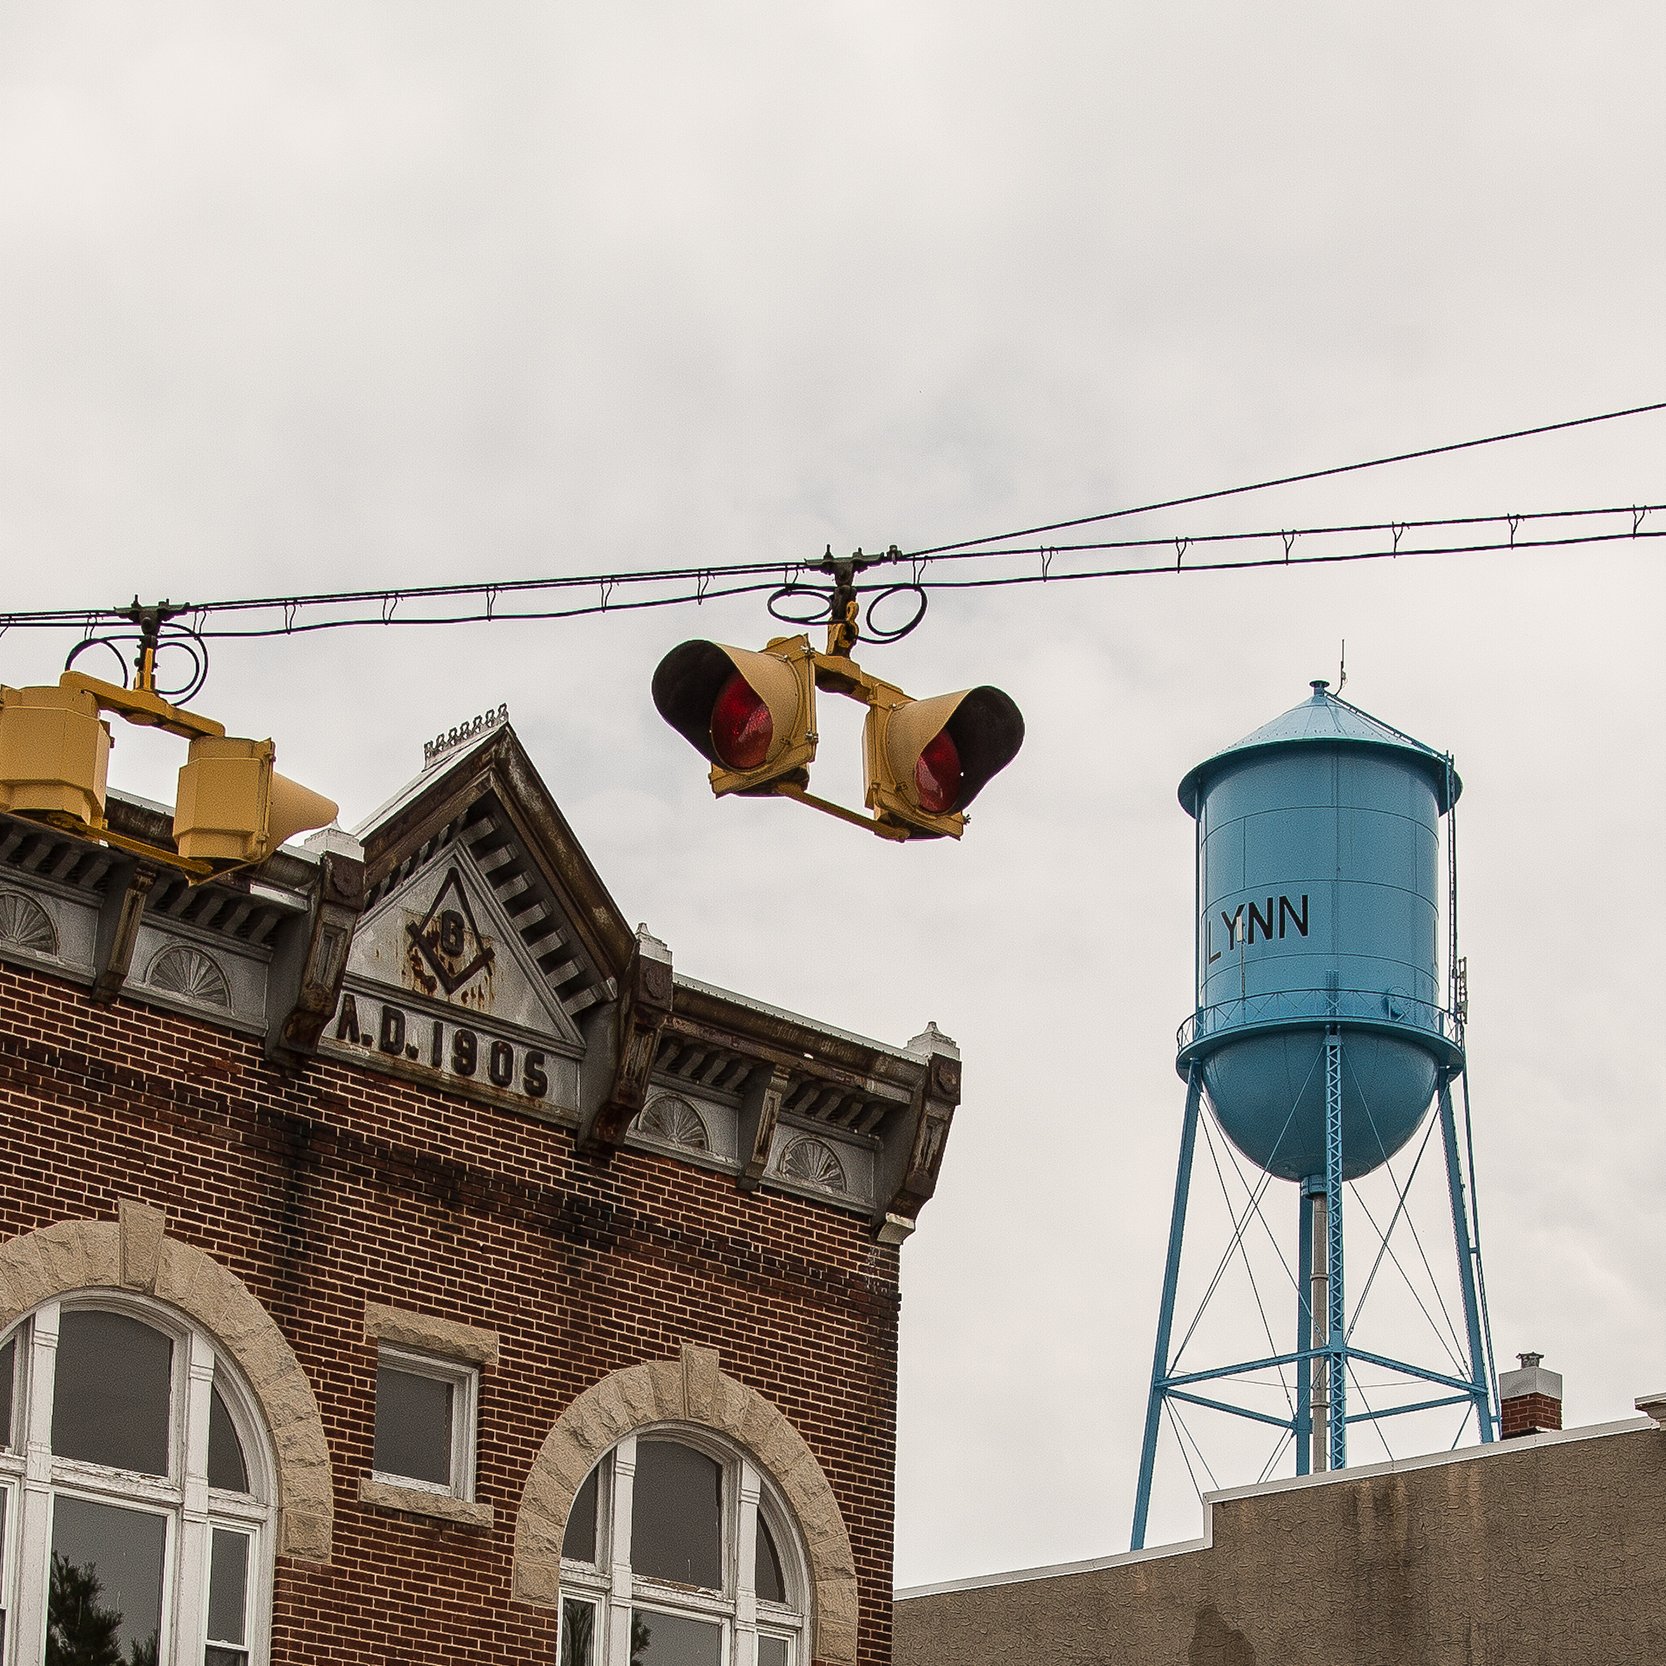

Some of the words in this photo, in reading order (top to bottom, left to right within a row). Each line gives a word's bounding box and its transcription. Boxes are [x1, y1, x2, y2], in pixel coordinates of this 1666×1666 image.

[1208, 893, 1309, 965] LYNN
[336, 993, 419, 1060] A.D.
[430, 1020, 549, 1098] 1905
